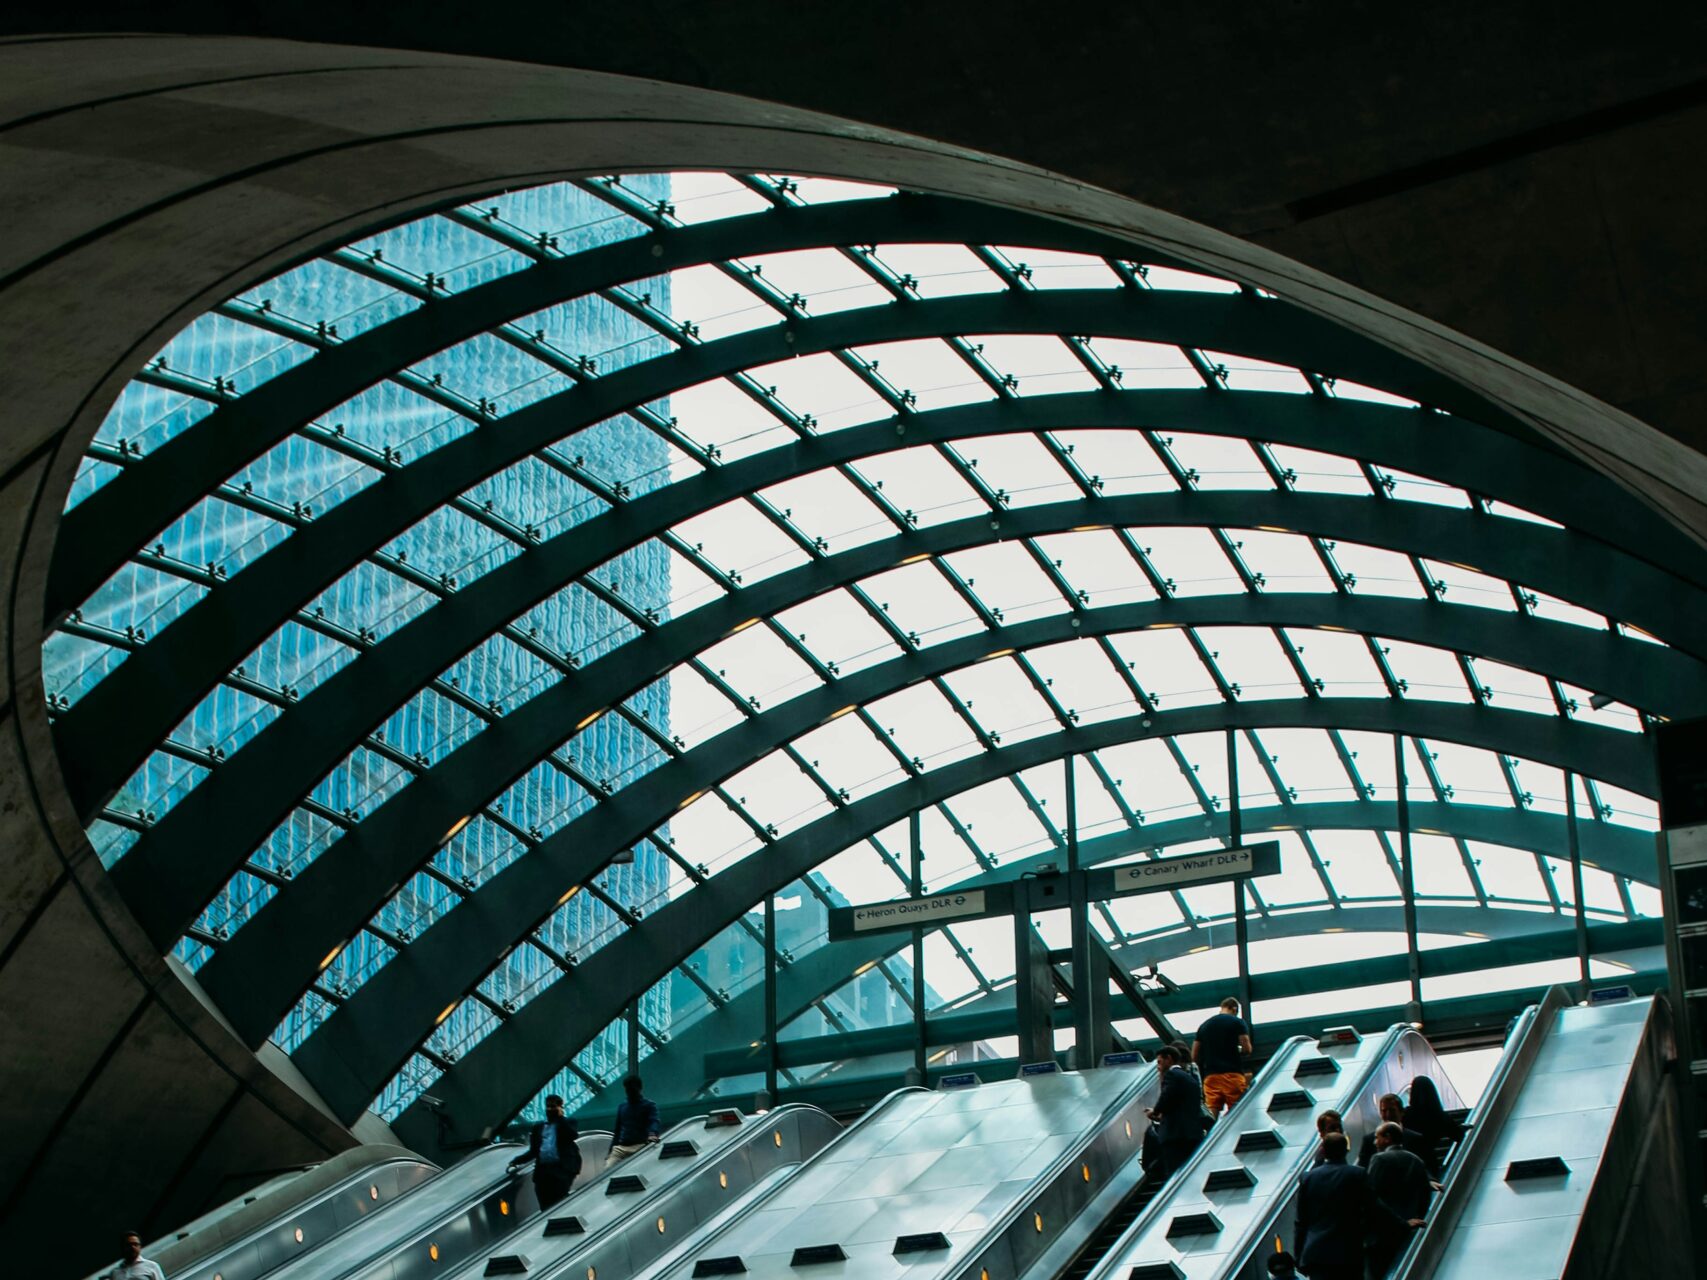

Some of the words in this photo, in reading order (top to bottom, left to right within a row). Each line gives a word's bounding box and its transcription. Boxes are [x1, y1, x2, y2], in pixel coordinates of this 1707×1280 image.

[1144, 864, 1179, 876] Canary
[1182, 858, 1214, 870] Wharf
[1217, 854, 1238, 865] DLR
[867, 908, 896, 918] Heron
[899, 904, 929, 914] Quays
[931, 899, 951, 909] DLR
